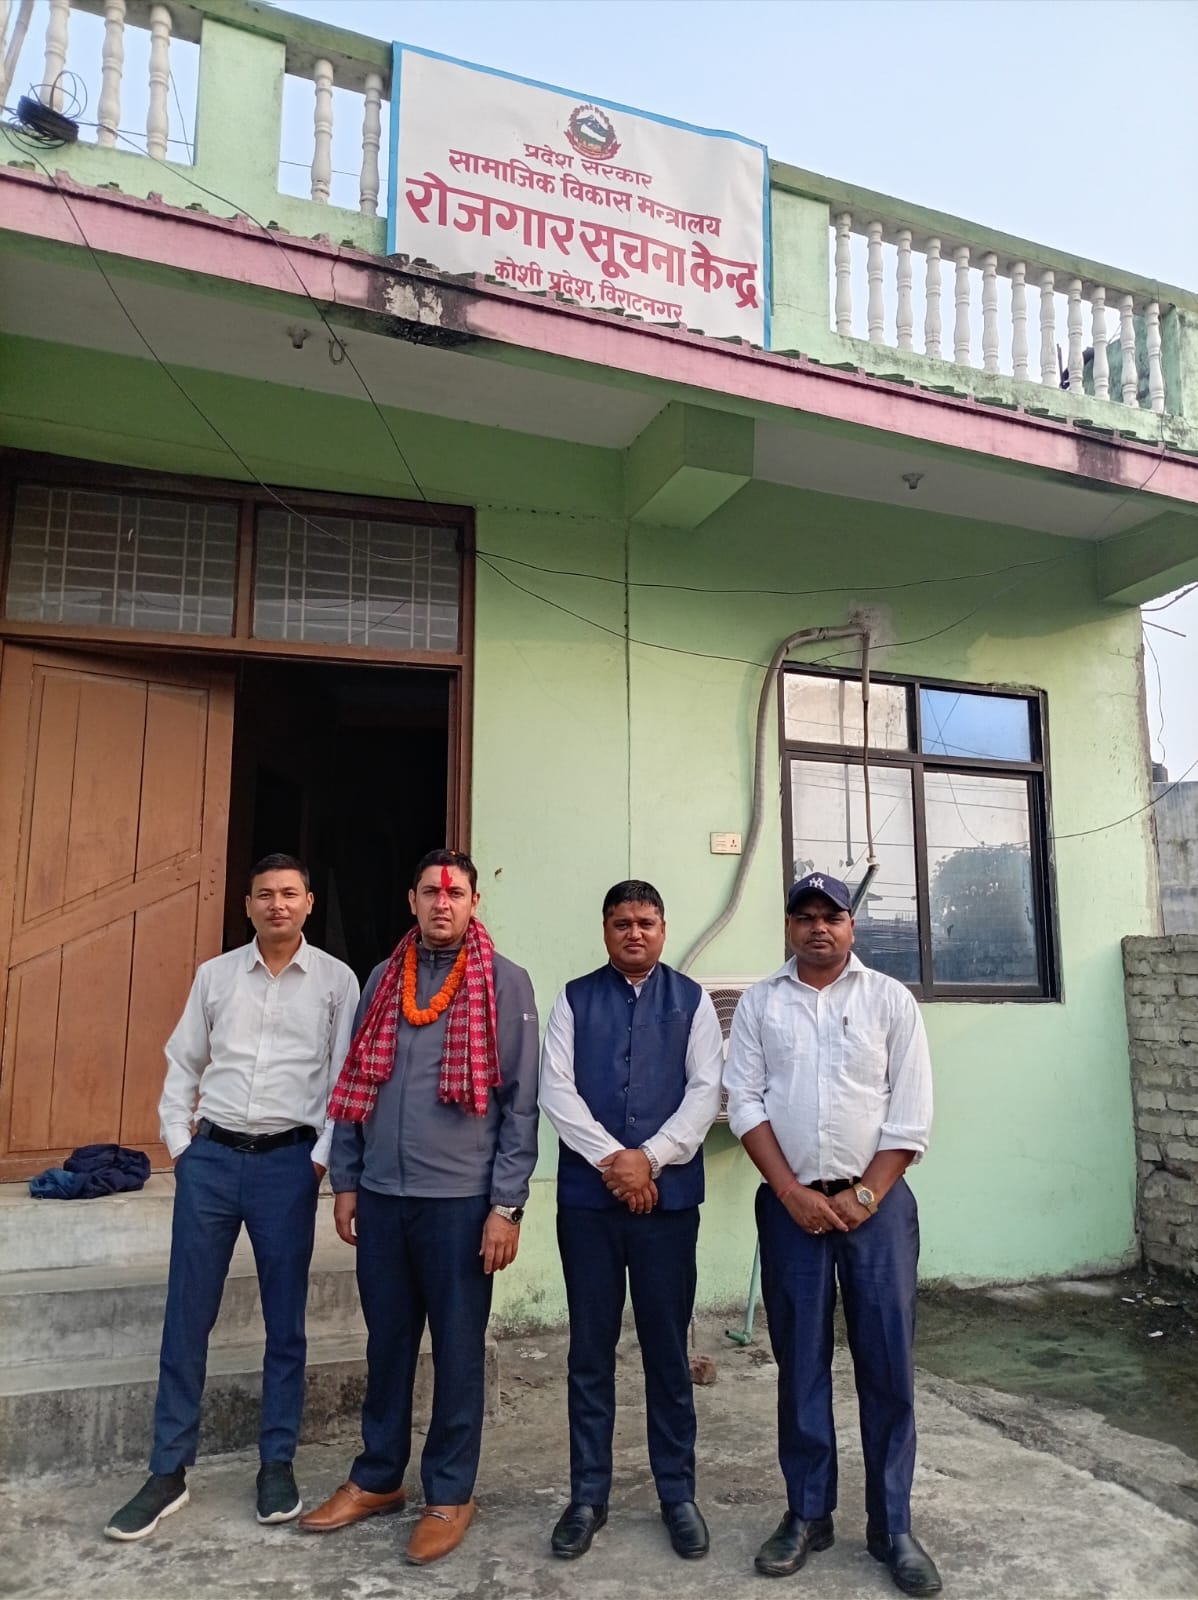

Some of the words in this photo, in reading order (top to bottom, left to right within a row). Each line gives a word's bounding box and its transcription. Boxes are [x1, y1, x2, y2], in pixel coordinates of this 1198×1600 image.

[449, 149, 556, 194] सामाजिक
[561, 173, 632, 212] विकास
[638, 196, 721, 237] मन्त्रालय
[524, 143, 574, 168] प्रदेश
[581, 158, 653, 190] सरकार
[406, 172, 574, 255] रोजगार
[580, 219, 685, 287] सूचना
[690, 240, 759, 310] केन्द्र
[494, 256, 542, 288] कोशी
[548, 270, 596, 303] प्रदेश,
[600, 280, 682, 320] विराटनगर
